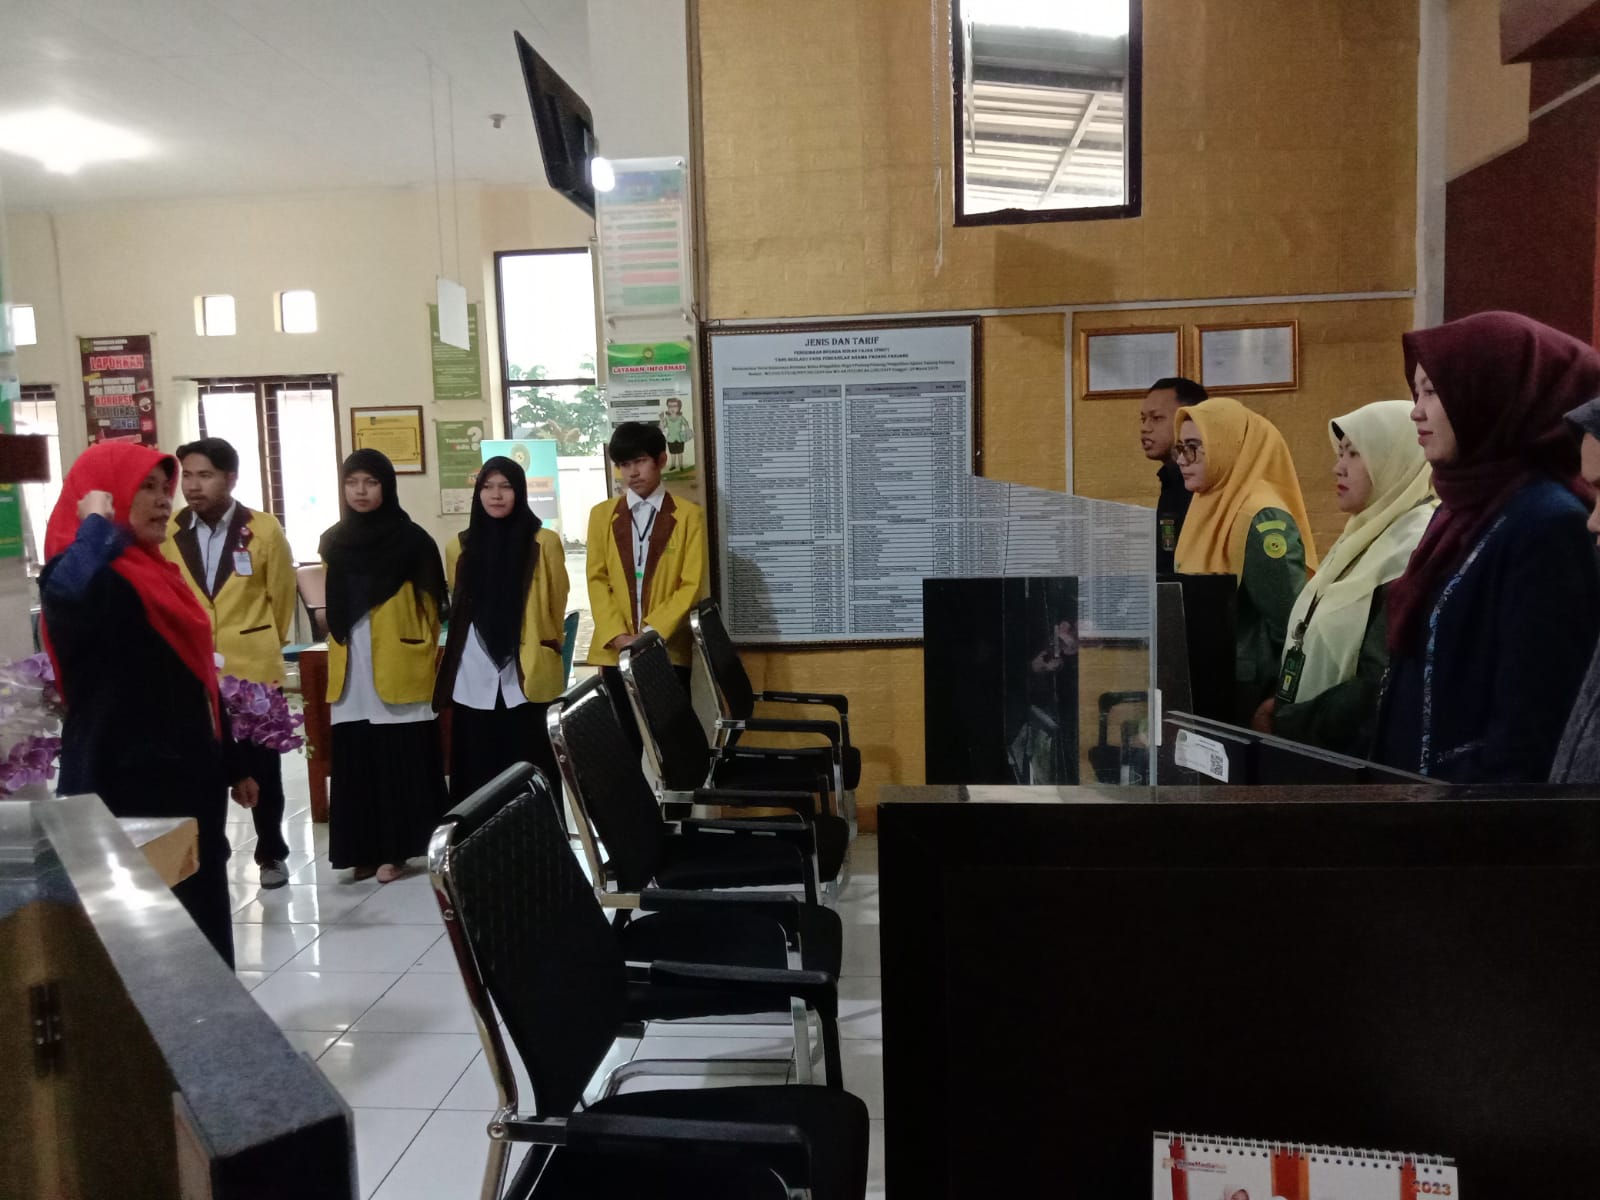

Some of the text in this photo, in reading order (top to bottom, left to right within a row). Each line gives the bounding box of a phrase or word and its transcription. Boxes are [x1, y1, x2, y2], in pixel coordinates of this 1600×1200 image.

[805, 336, 880, 347] JENIS DAN TARIF
[90, 354, 144, 370] LAPORKAN
[646, 364, 686, 372] INFORMASI
[1411, 1180, 1452, 1196] 2023
